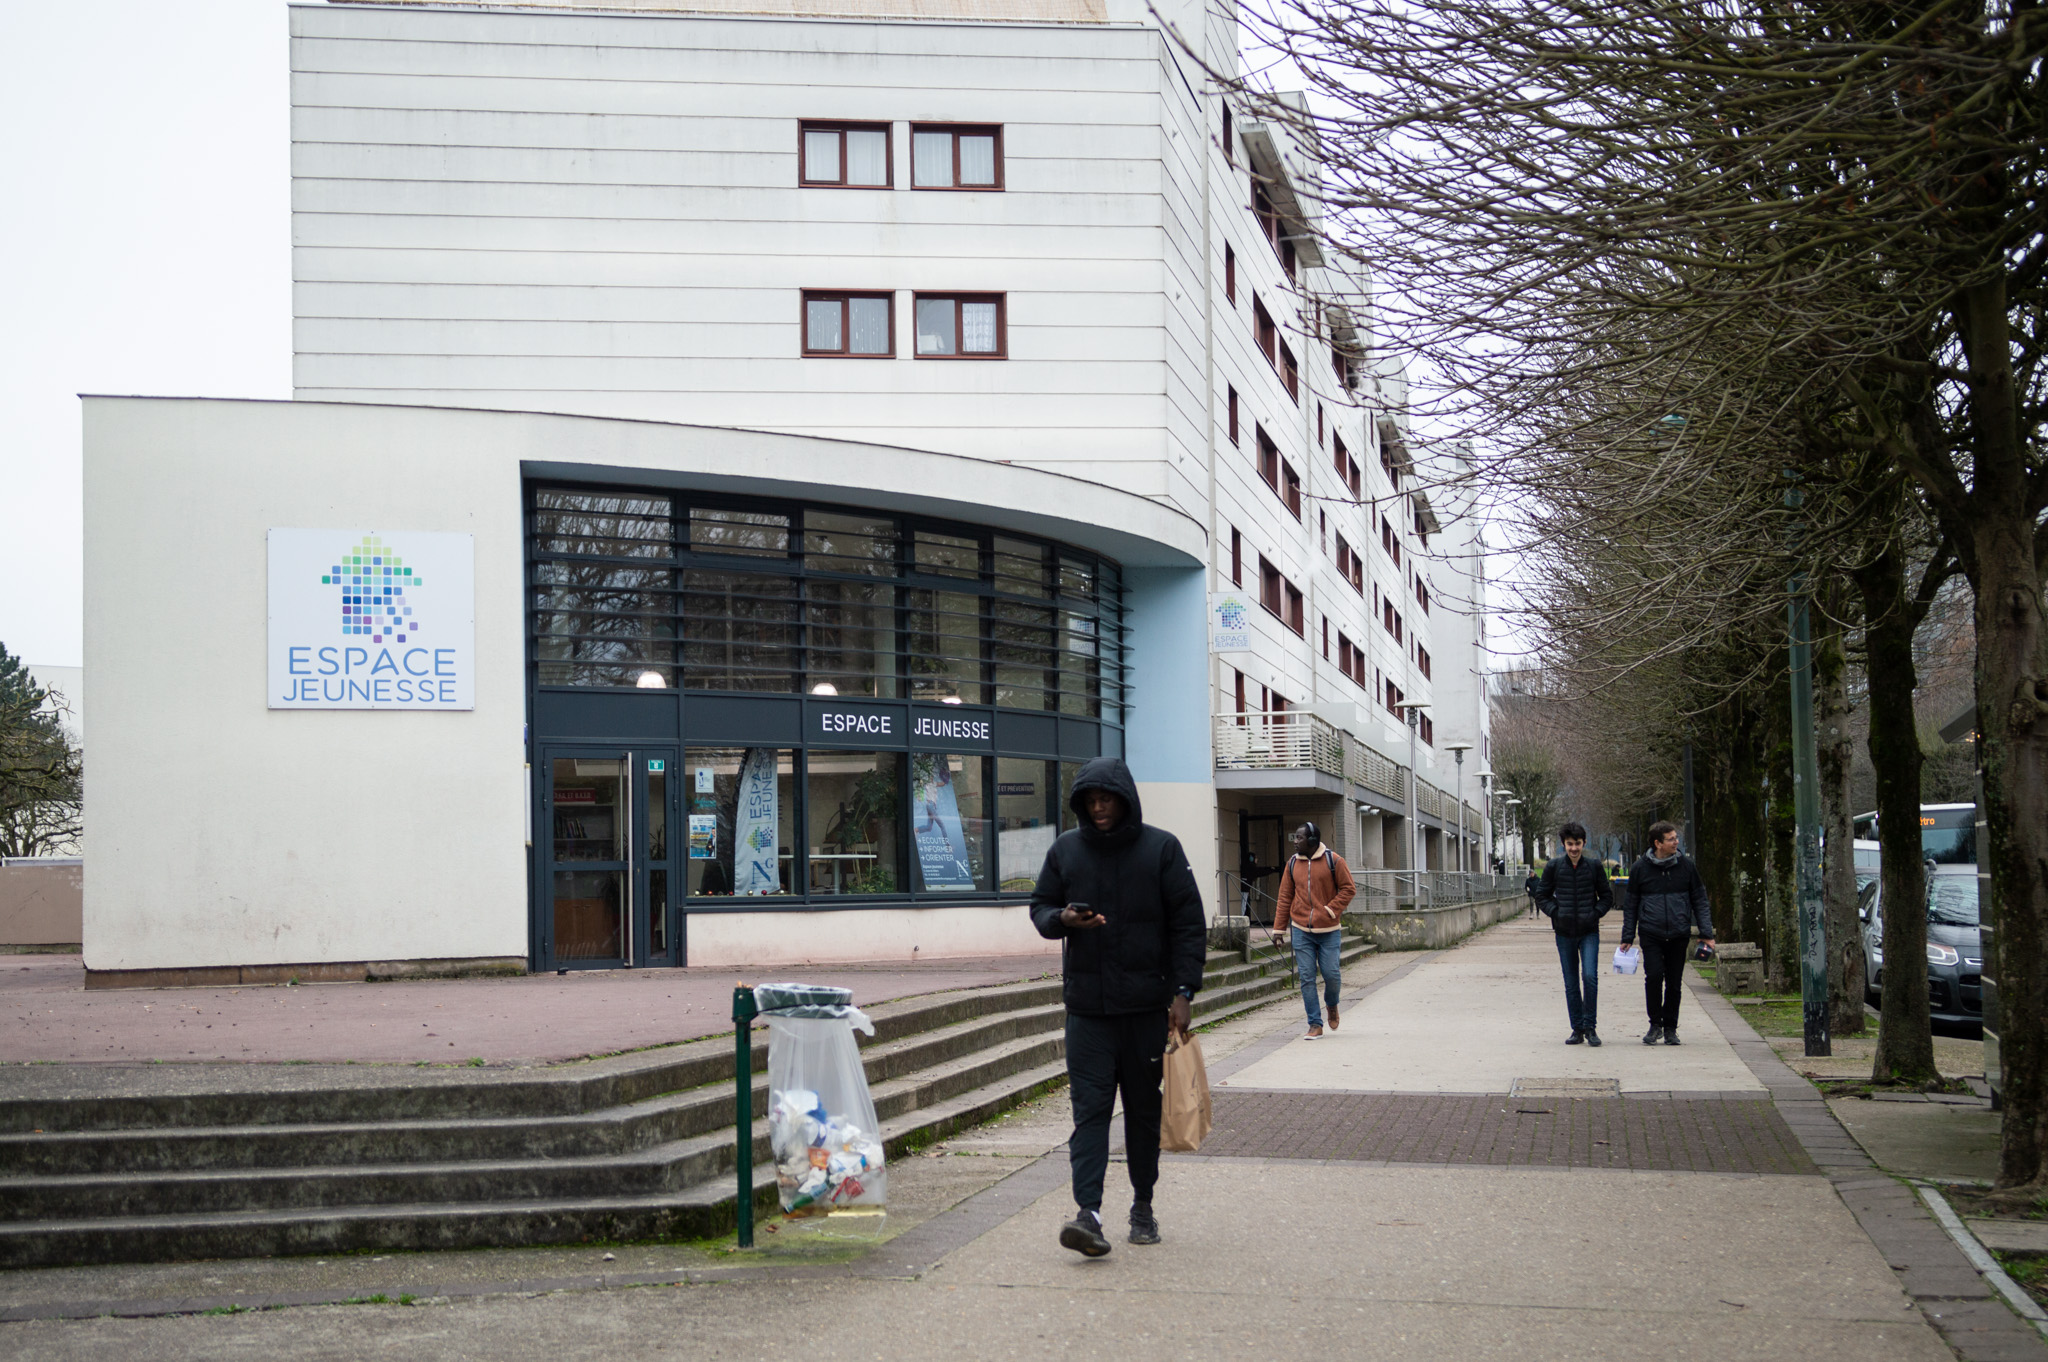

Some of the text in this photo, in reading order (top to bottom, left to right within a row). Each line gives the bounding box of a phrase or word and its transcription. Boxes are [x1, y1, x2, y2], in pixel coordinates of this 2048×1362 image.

[1214, 634, 1248, 643] ESPACE
[289, 646, 456, 676] ESPACE
[282, 678, 456, 702] JEUNESSE
[822, 713, 989, 740] ESPACE JEUNESSE
[762, 747, 772, 820] JEUNESS
[923, 845, 953, 853] INFORMER
[925, 853, 955, 862] ORIENTER
